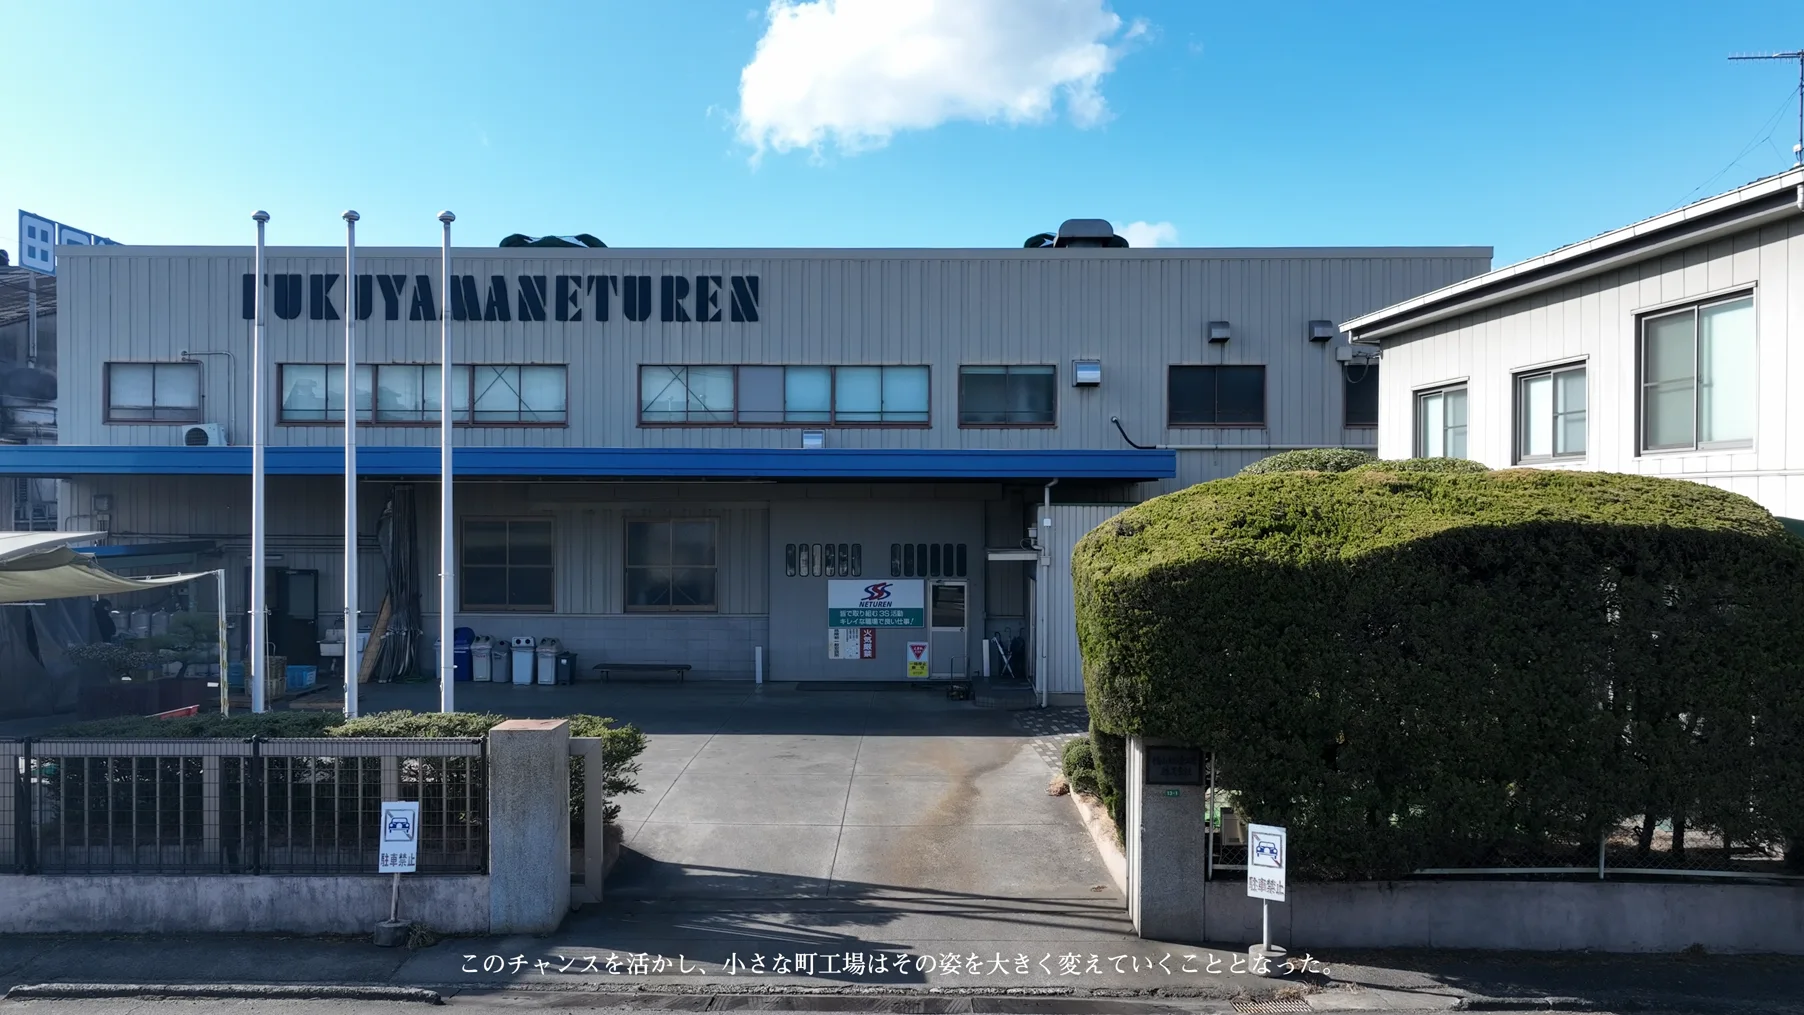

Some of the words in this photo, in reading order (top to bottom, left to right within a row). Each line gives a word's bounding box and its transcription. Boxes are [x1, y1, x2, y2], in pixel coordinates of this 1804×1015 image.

[380, 853, 415, 867] 駐車禁止
[1249, 876, 1285, 896] 駐車禁止
